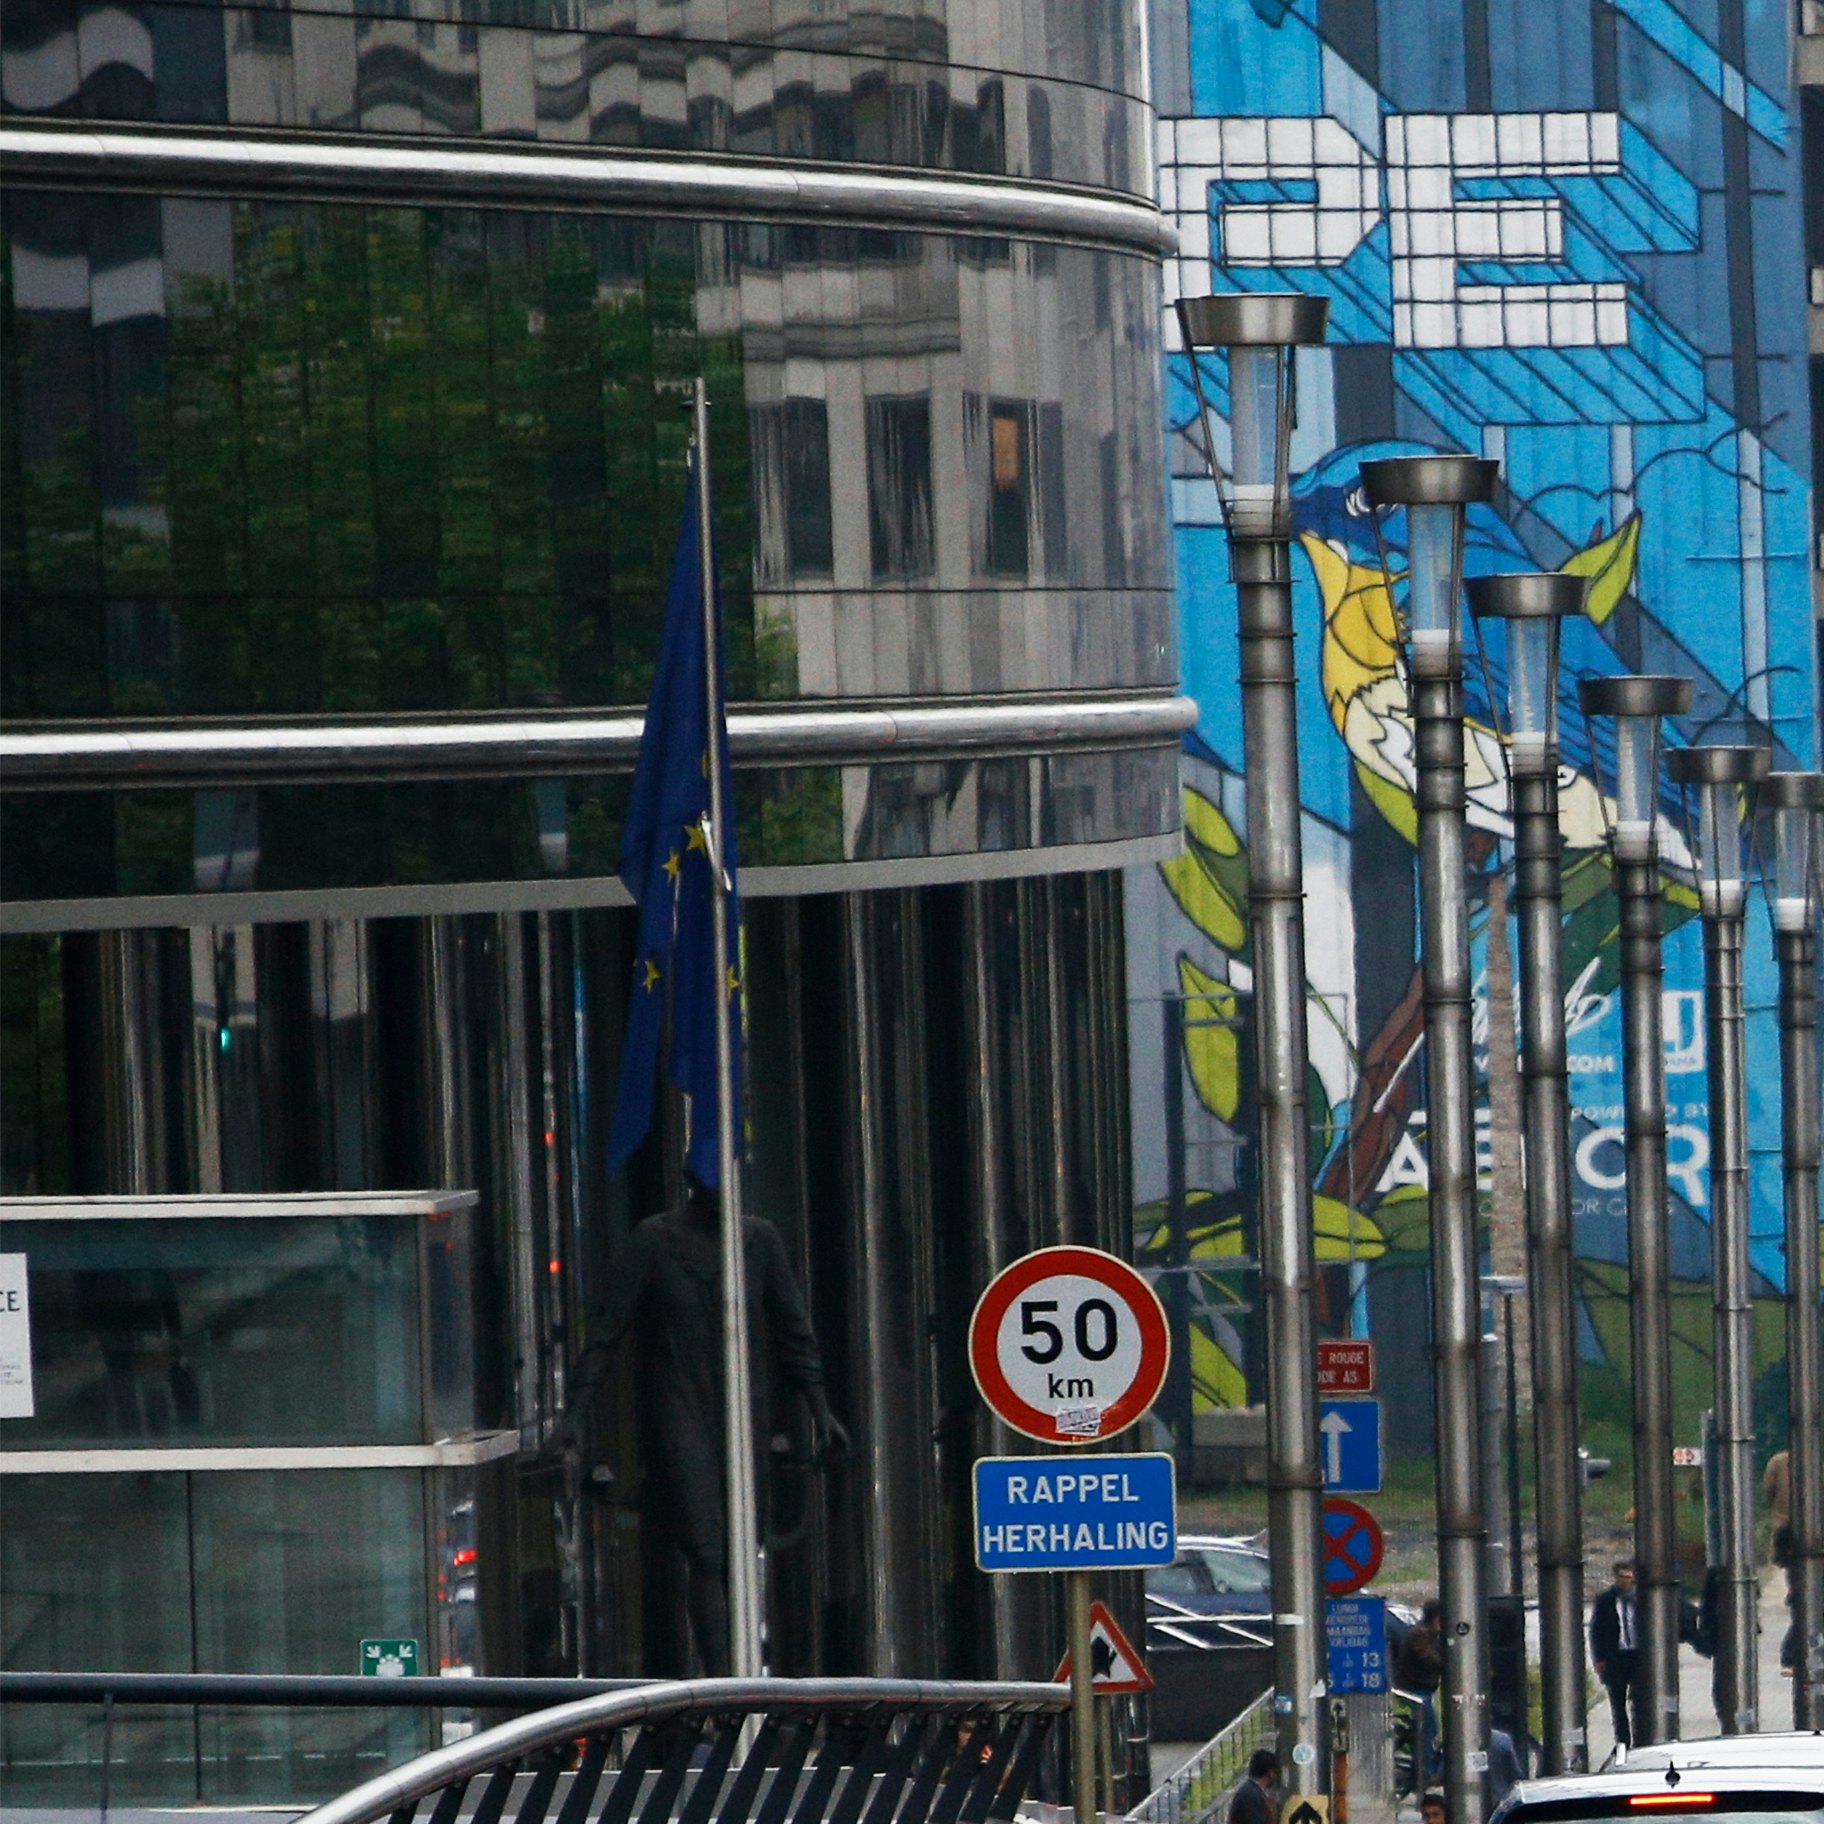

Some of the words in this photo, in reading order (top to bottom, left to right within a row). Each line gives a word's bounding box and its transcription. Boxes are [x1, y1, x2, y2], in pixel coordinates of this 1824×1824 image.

[1020, 1298, 1118, 1365] 50
[1328, 1351, 1364, 1365] ROUGE
[1047, 1372, 1094, 1400] km
[1008, 1473, 1141, 1504] RAPPEL
[982, 1520, 1168, 1553] HERHALING
[1361, 1652, 1380, 1668] 13
[1361, 1672, 1380, 1688] 18
